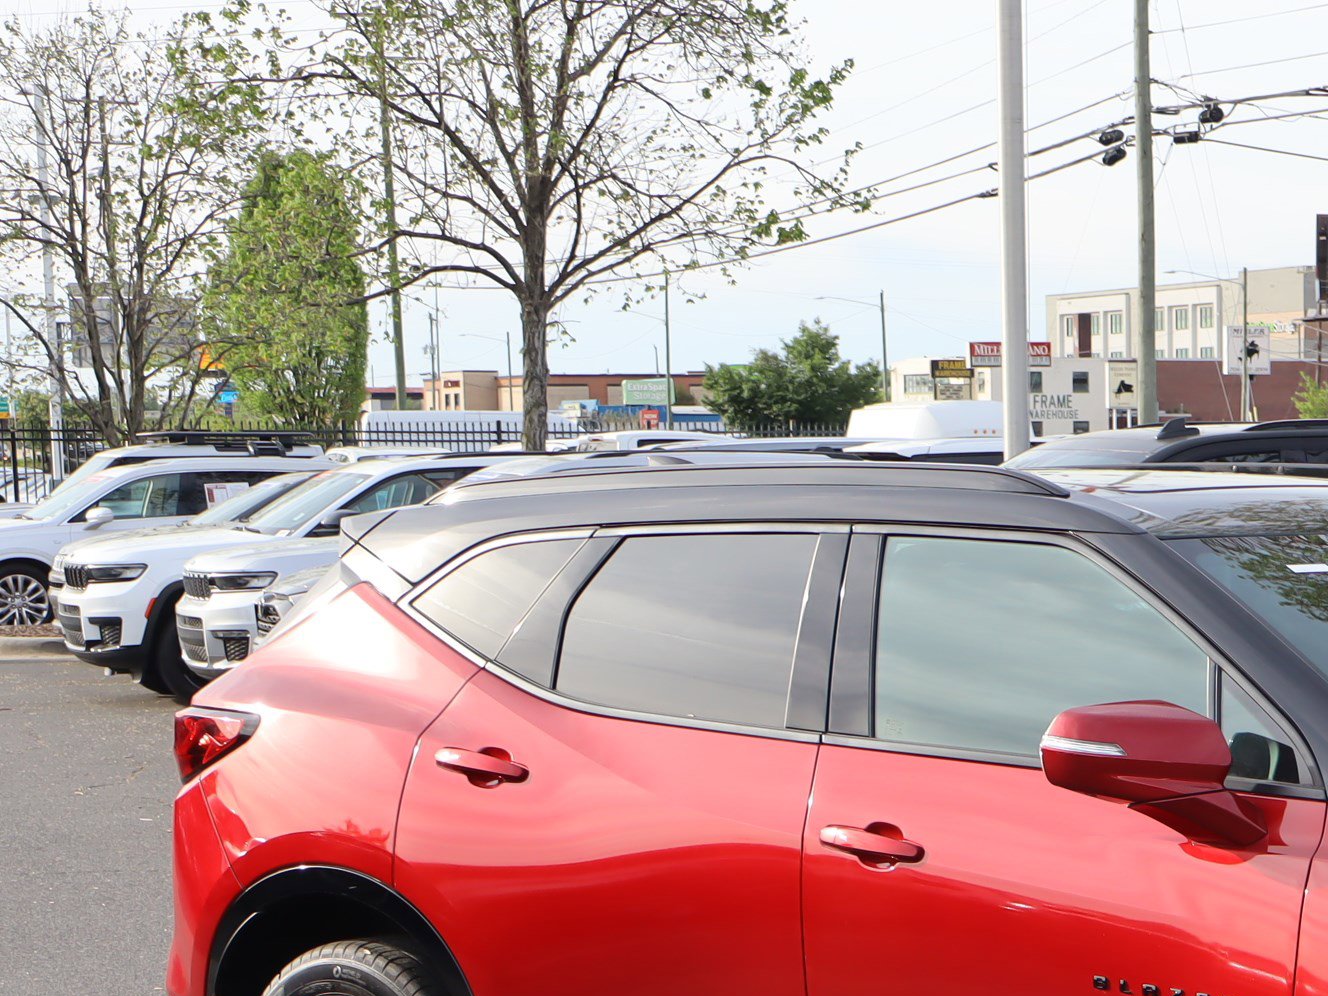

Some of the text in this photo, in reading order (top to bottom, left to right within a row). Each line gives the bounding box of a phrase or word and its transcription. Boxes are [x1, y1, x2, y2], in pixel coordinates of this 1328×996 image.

[974, 344, 1001, 355] MILL
[939, 361, 966, 370] FRAME
[1033, 395, 1072, 409] FRAME
